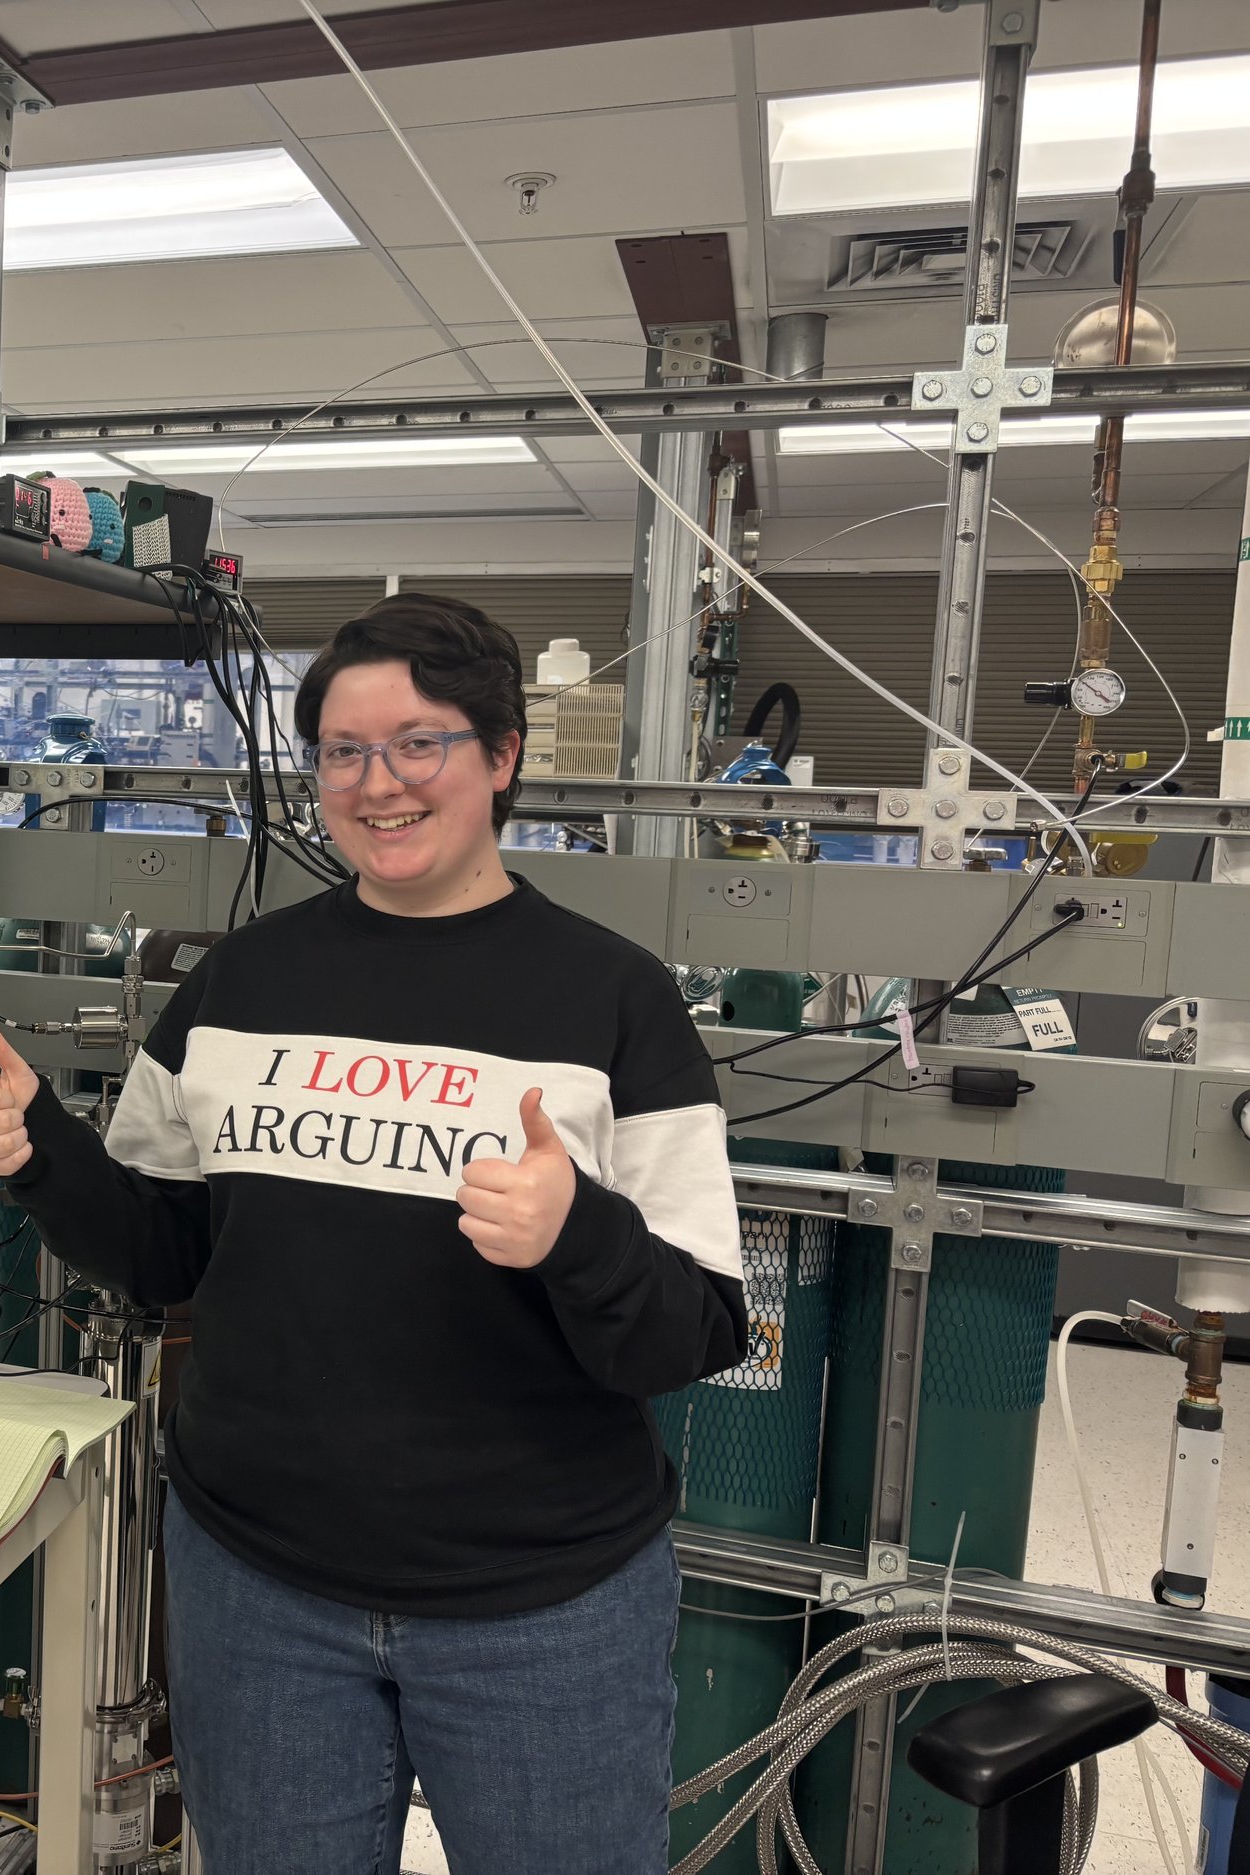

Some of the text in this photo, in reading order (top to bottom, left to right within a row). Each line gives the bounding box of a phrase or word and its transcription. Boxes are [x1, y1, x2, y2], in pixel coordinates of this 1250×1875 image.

[1018, 1006, 1051, 1018] PART FULL
[1032, 1021, 1064, 1038] FULL
[259, 1049, 480, 1108] I LOVE
